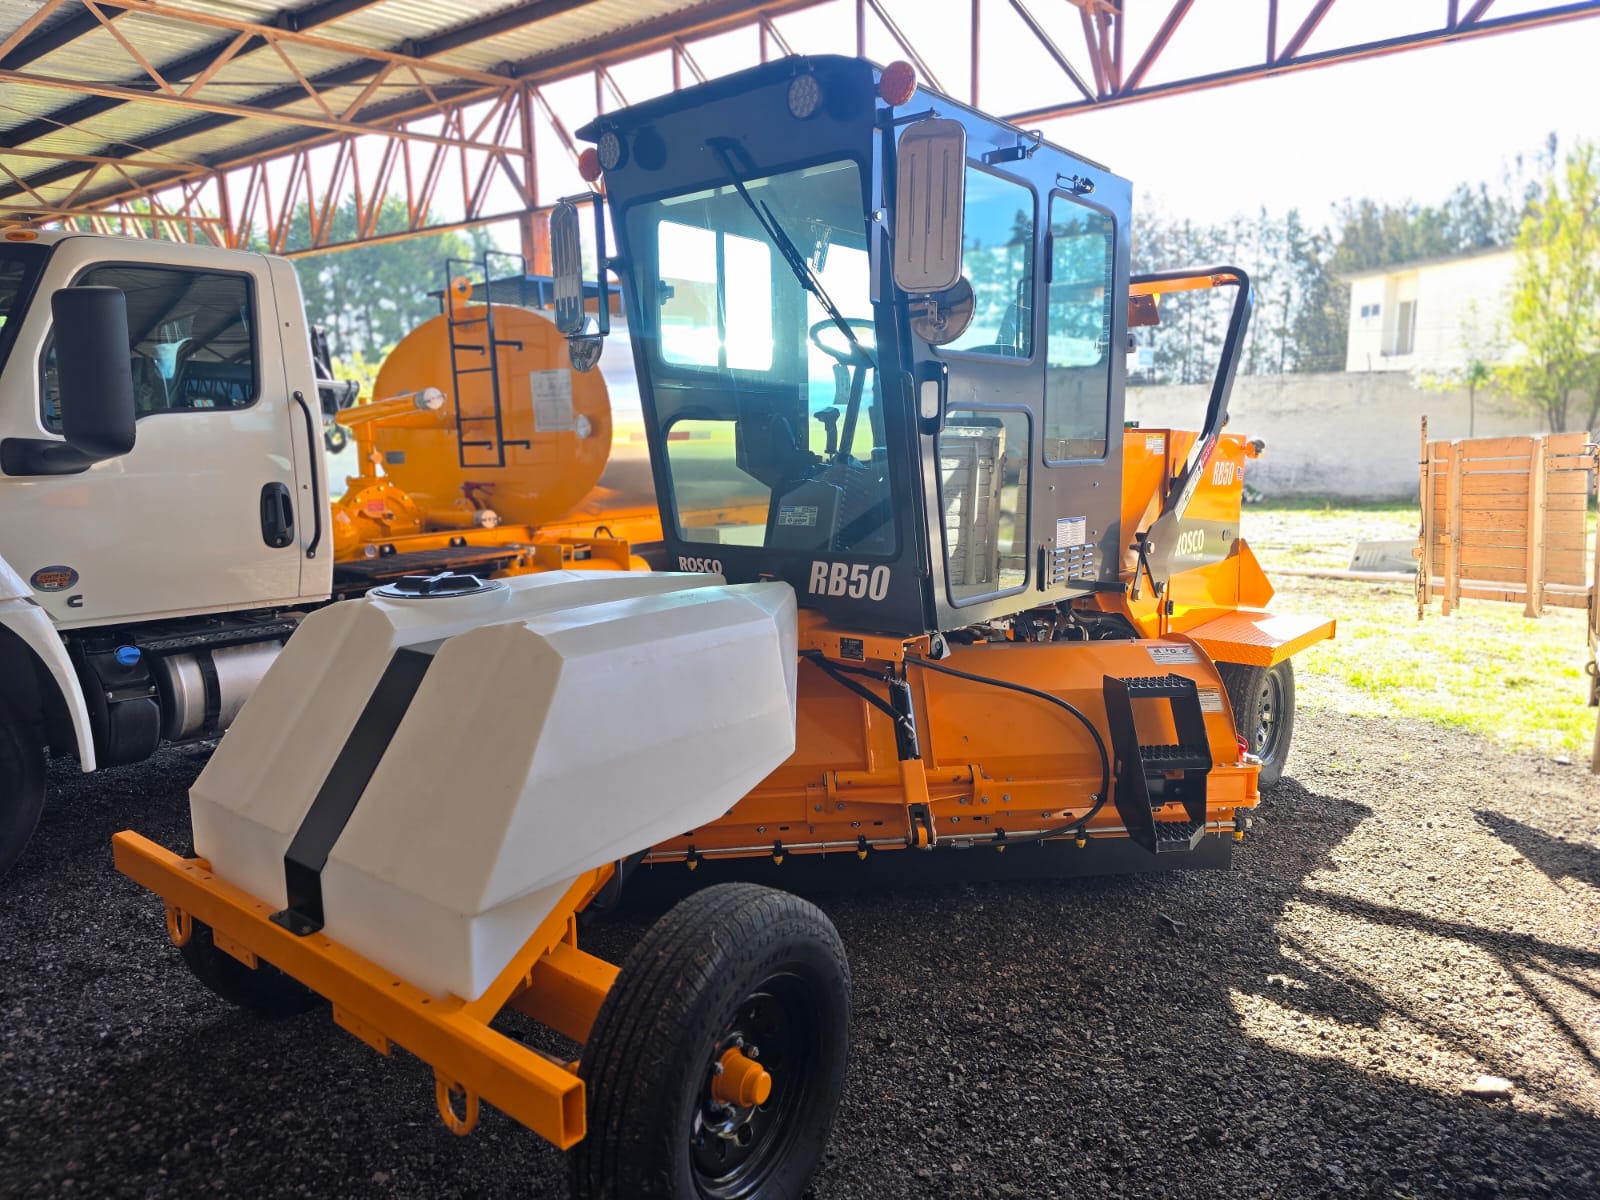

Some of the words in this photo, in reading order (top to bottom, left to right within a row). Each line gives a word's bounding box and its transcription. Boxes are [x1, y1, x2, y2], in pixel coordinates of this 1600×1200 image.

[1212, 461, 1235, 486] RB50
[678, 555, 723, 575] ROSCO
[808, 560, 891, 602] RB50
